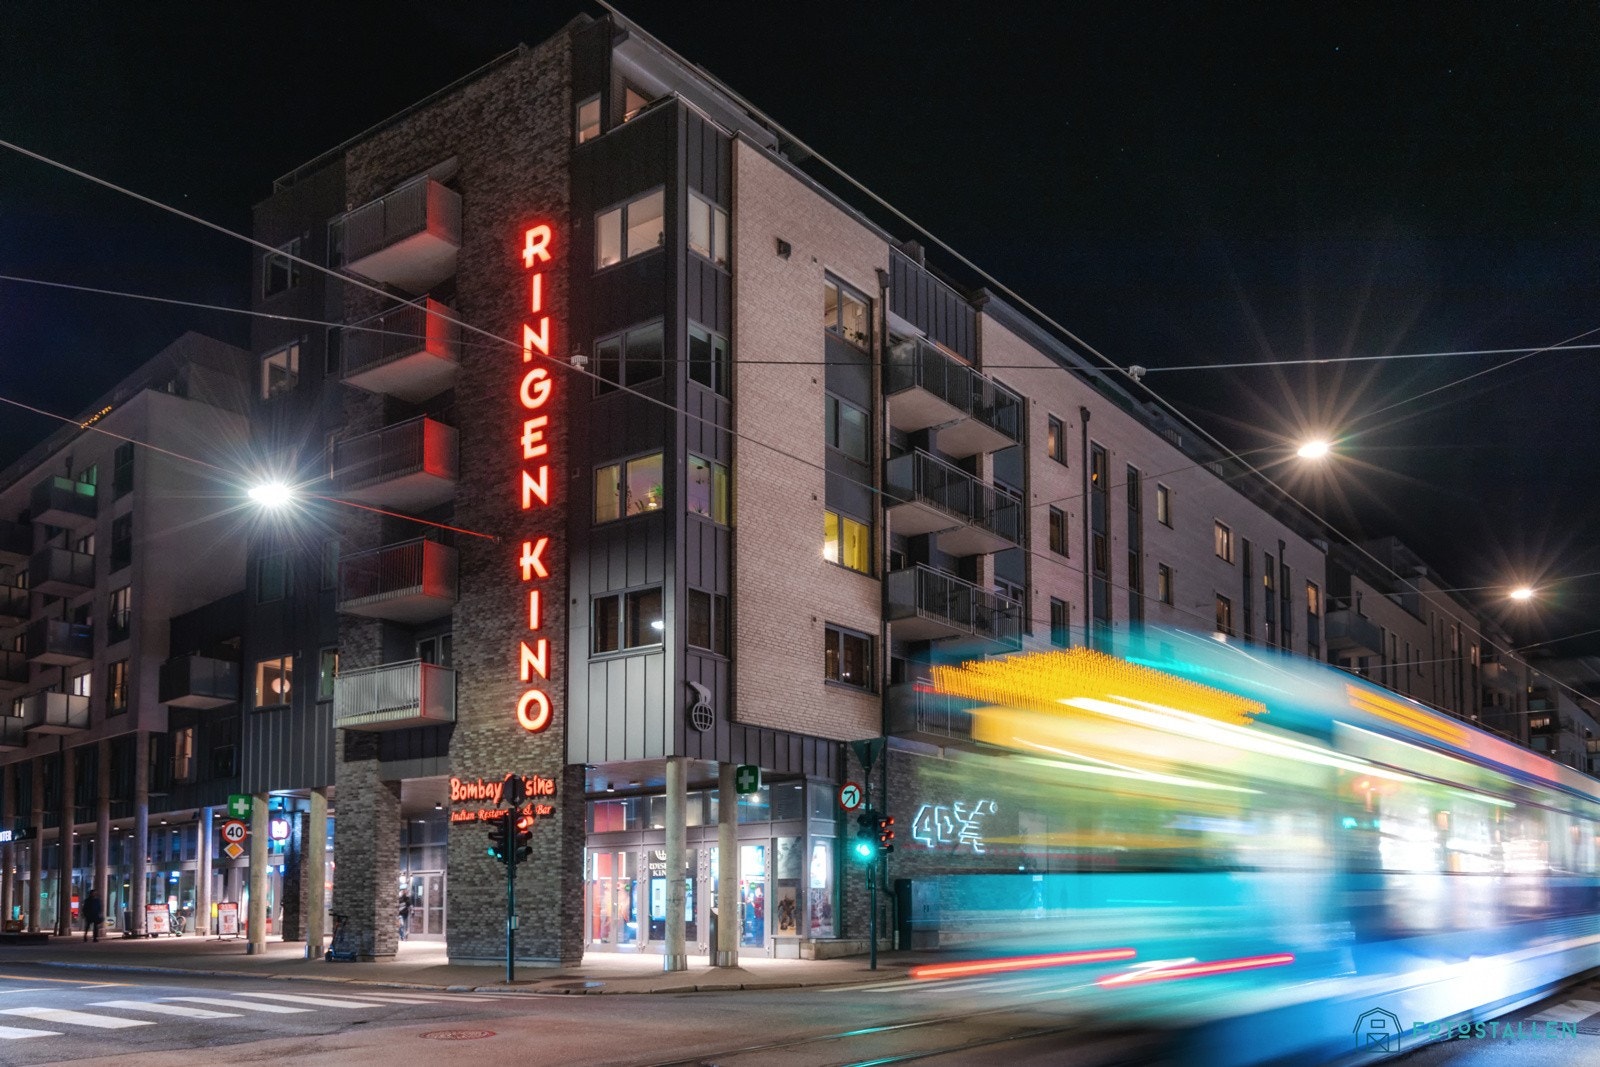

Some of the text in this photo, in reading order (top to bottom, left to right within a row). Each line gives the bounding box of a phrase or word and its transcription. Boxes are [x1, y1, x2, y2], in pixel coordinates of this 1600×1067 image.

[517, 224, 552, 732] RINGEN KINO
[450, 772, 554, 804] Bombay sine
[450, 809, 475, 822] Indian
[523, 803, 532, 816] &
[536, 804, 553, 815] Bar
[227, 827, 243, 837] 40
